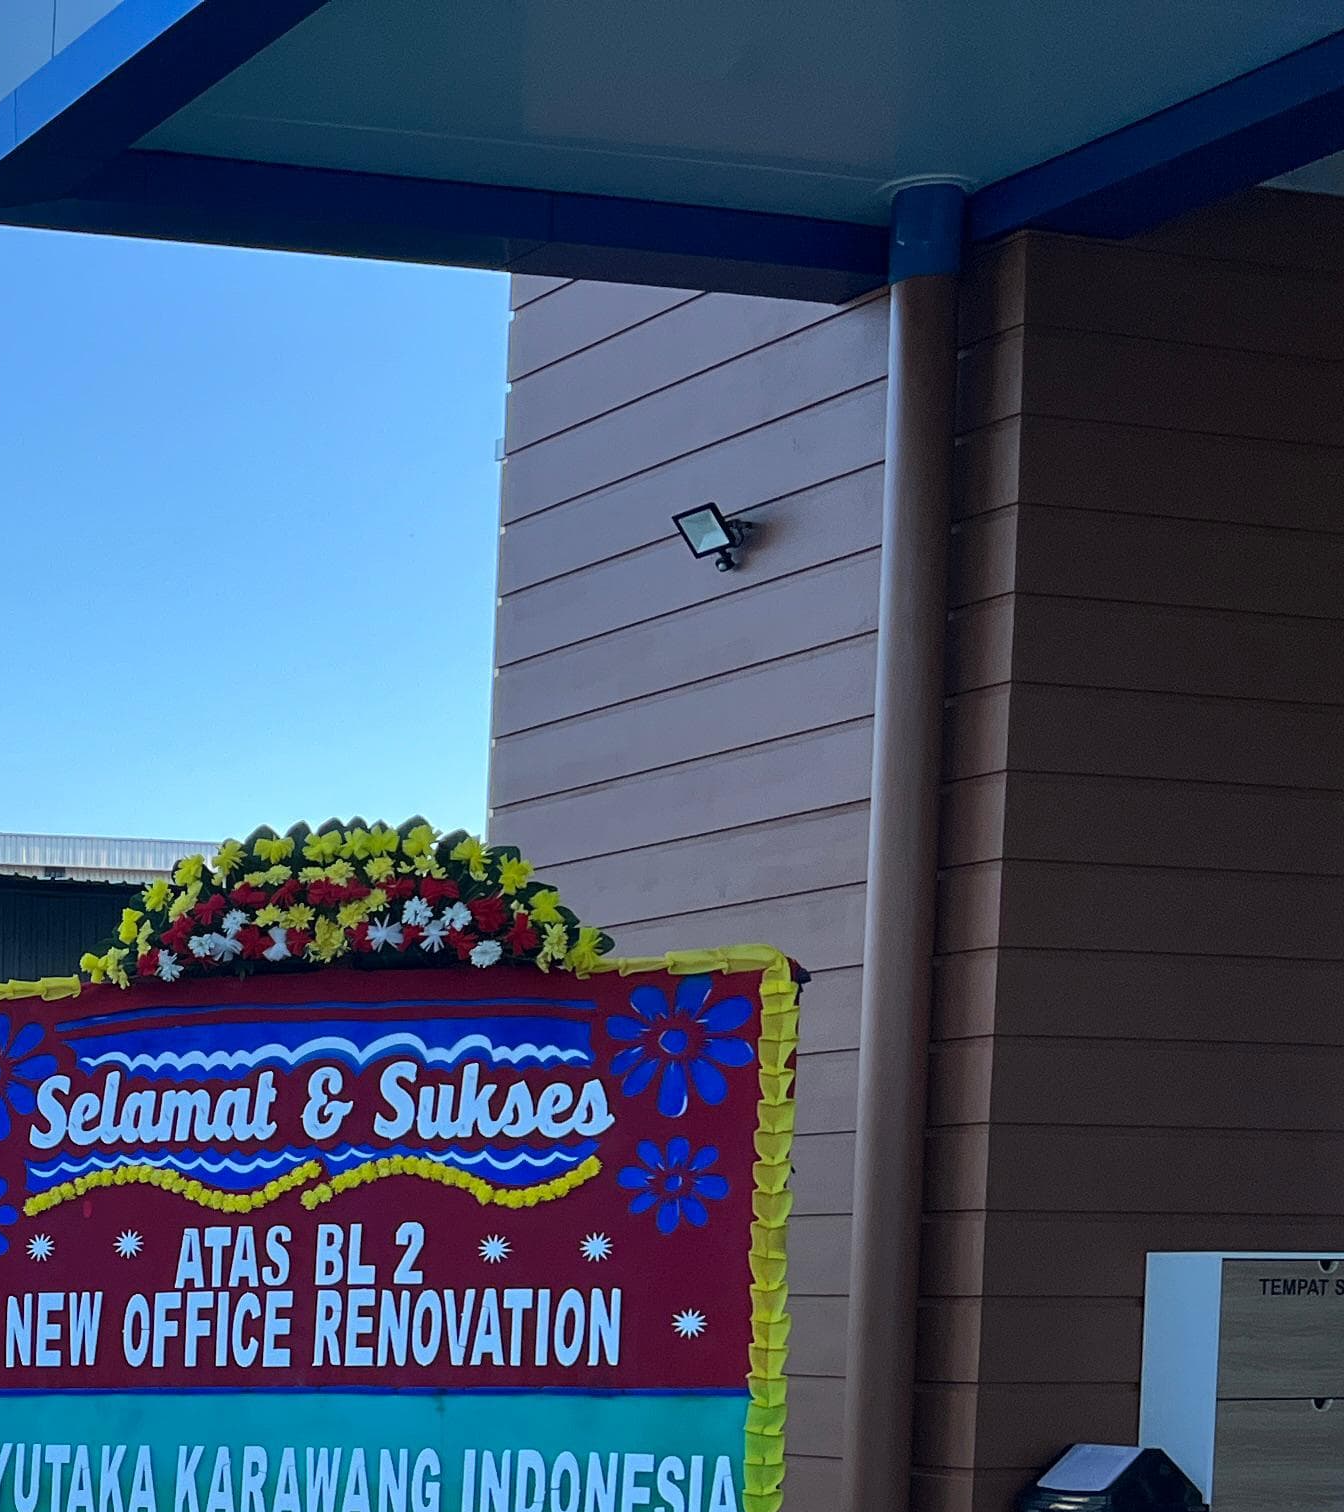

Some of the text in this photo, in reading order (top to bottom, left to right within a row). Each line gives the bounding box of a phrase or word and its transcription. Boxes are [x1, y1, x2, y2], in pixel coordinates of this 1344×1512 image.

[27, 1062, 615, 1149] Selamat & Sukses
[173, 1221, 426, 1289] ATAS BL 2
[1258, 1278, 1330, 1296] TEMPAT
[3, 1287, 623, 1368] NEW OFFICE RENOVATION
